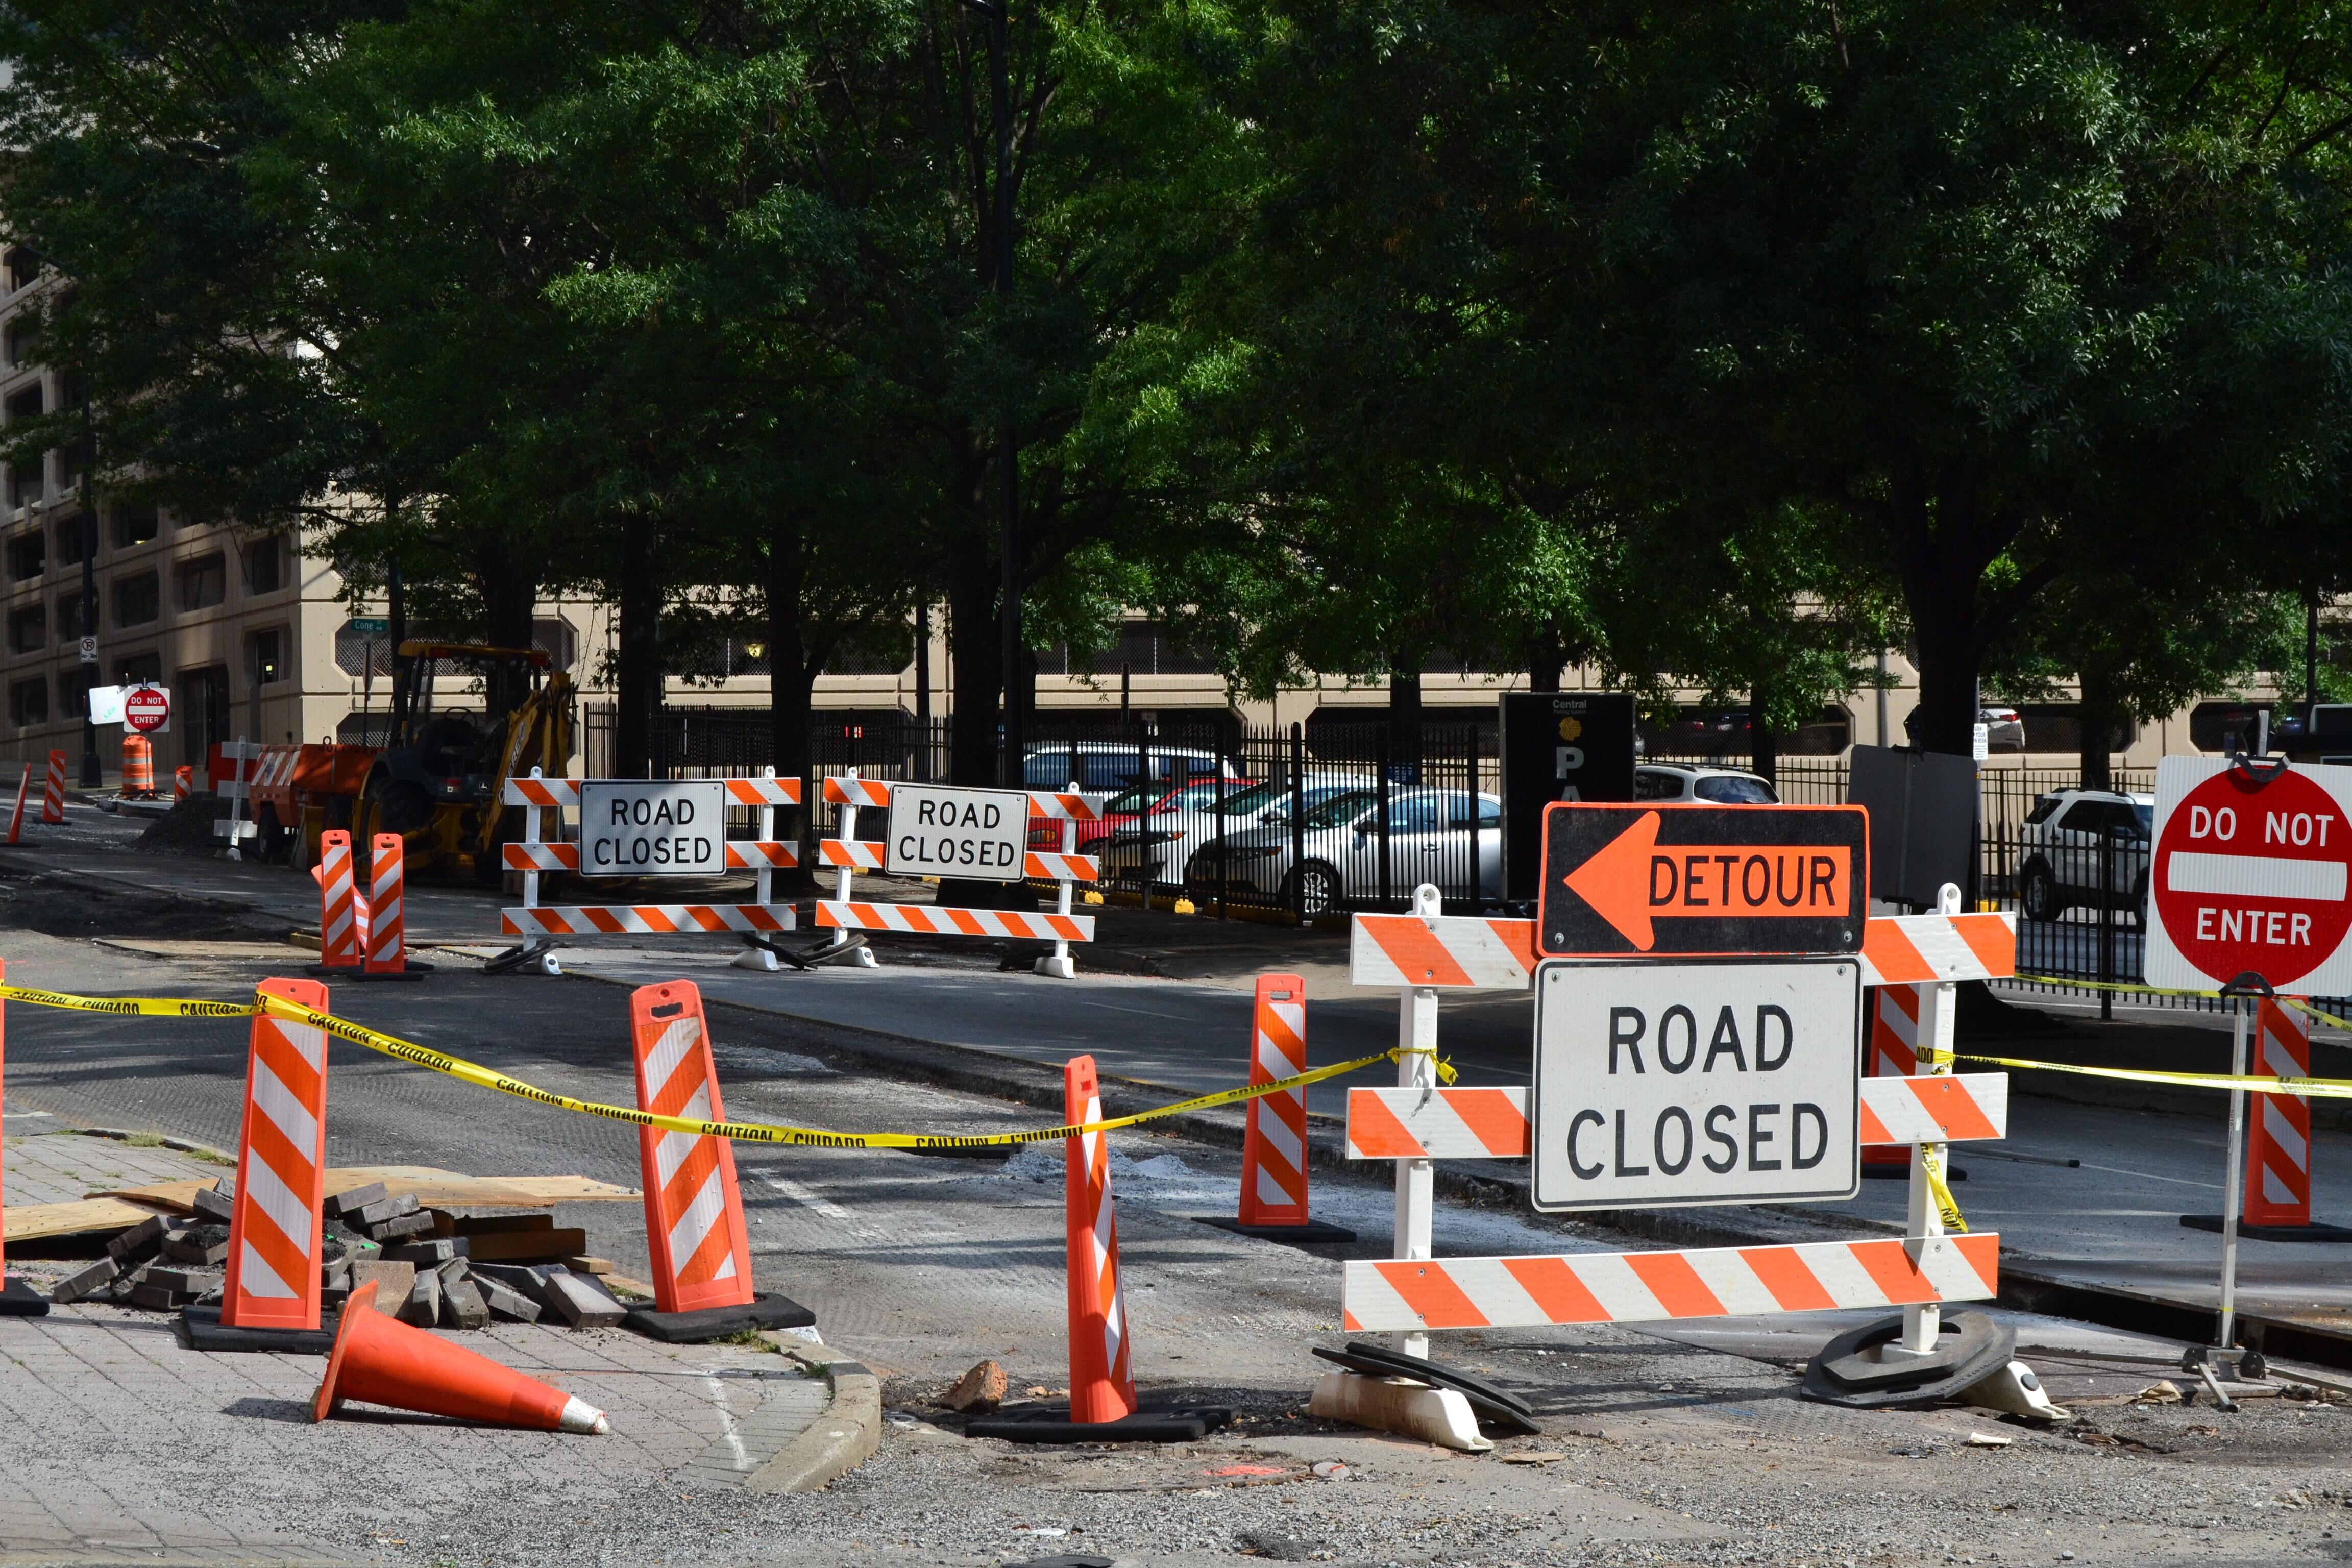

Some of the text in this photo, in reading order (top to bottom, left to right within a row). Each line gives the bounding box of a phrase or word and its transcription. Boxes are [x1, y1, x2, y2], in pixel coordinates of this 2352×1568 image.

[355, 621, 374, 630] Cone
[1553, 699, 1587, 708] Central
[134, 716, 159, 724] ENTER
[611, 798, 694, 826] ROAD
[918, 800, 1000, 829] ROAD
[2190, 805, 2334, 847] DO NOT
[594, 837, 711, 865] CLOSED
[899, 836, 1014, 867] CLOSED
[1649, 854, 1836, 908] DETOUR
[2197, 907, 2311, 946] ENTER
[82, 1000, 140, 1014] CUIDADO
[308, 1013, 372, 1044] CAUTION
[387, 1043, 453, 1072] CUIDADO
[1608, 1004, 1793, 1074] ROAD
[496, 1079, 563, 1106] CAUTION
[701, 1124, 773, 1141] CAUTION
[794, 1133, 866, 1148] CUIDADO
[1567, 1103, 1828, 1180] CLOSED
